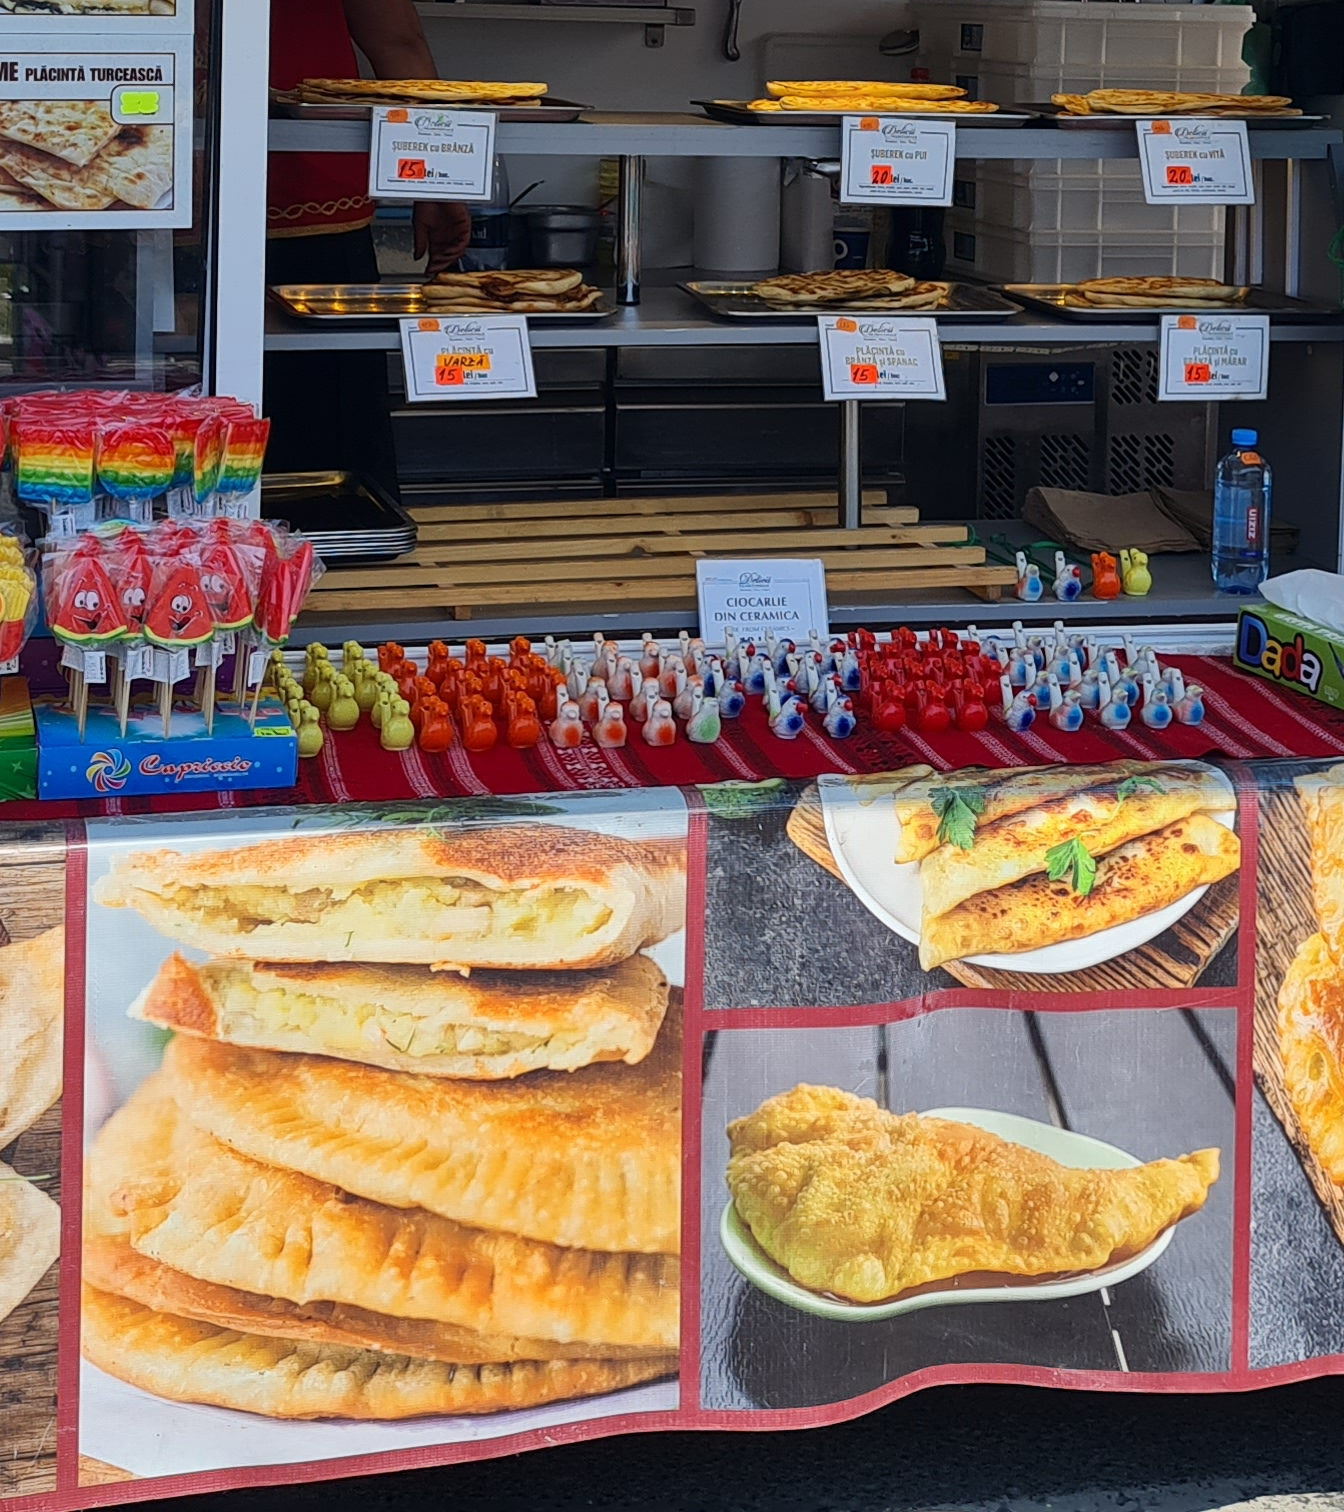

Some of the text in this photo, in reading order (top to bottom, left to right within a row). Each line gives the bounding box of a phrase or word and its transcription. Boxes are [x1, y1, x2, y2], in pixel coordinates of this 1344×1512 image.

[25, 65, 85, 82] PLĂCINTĂ
[90, 65, 163, 82] TURCEASCĂ
[915, 151, 927, 160] PUI
[399, 161, 422, 178] 15
[872, 170, 889, 184] 20
[438, 368, 458, 381] 15
[852, 368, 870, 381] 15
[1187, 366, 1204, 380] 15
[726, 597, 787, 608] CIOCARLIE
[714, 611, 800, 622] DIN CERAMICA
[1237, 611, 1323, 694] Dada
[138, 754, 253, 783] Capriccio
